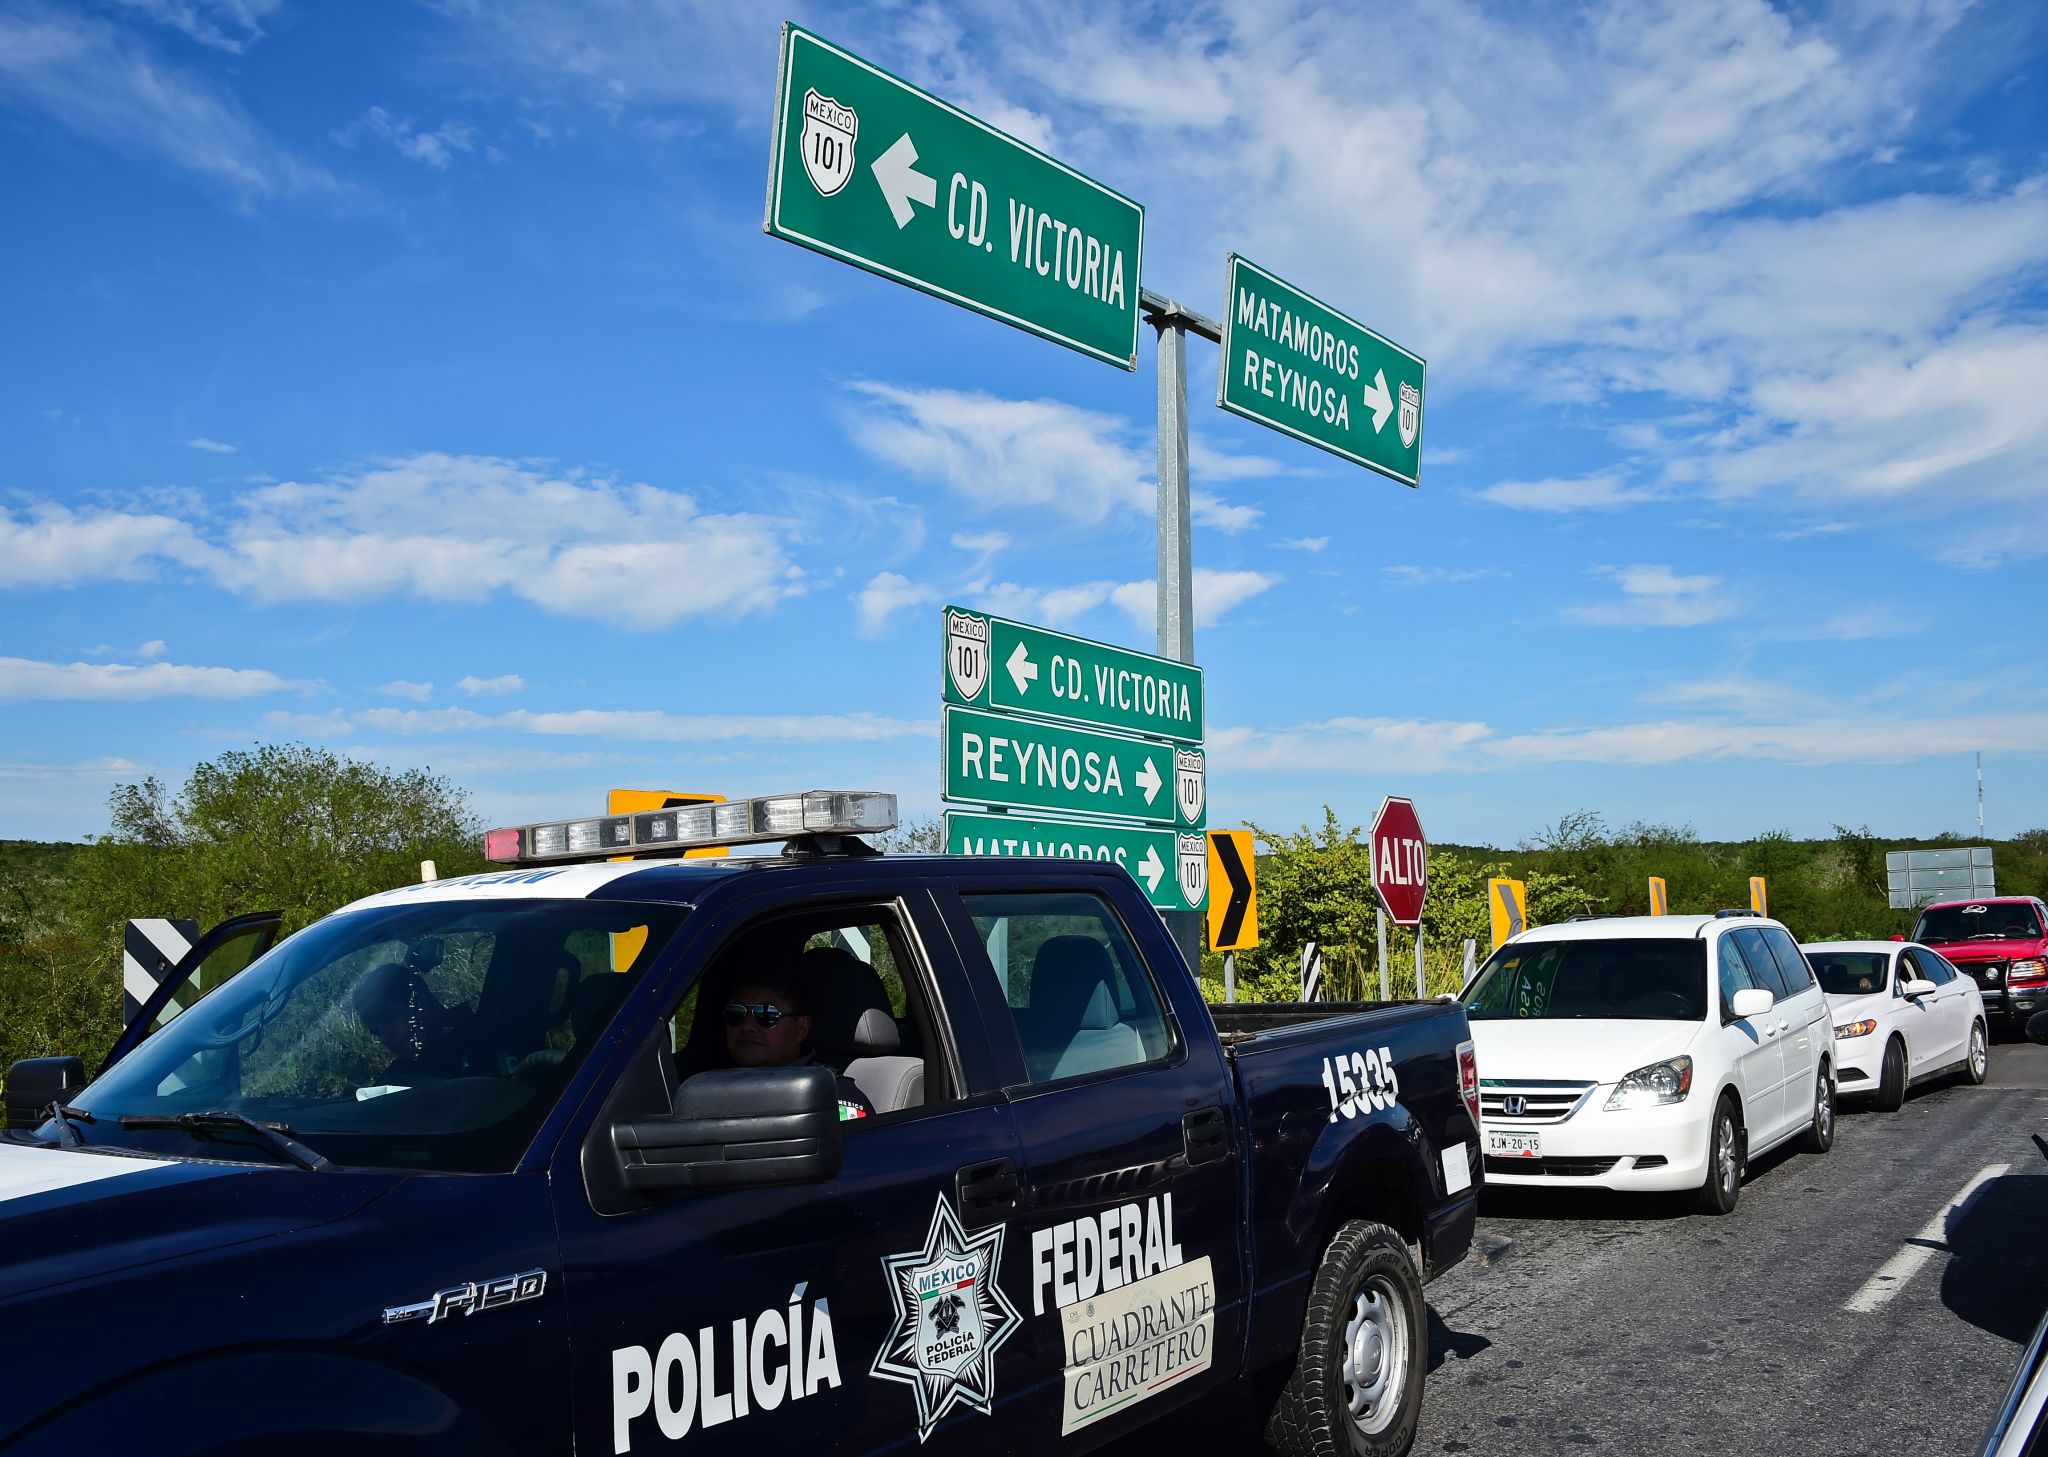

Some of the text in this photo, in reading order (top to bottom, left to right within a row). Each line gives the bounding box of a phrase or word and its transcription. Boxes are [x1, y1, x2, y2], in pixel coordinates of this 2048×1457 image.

[810, 99, 852, 129] MEXICO
[815, 132, 843, 174] 101
[948, 172, 1125, 311] CD. VICTORIA
[1238, 286, 1359, 380] MATAMOROS
[1243, 349, 1350, 431] REYNOSA
[1402, 407, 1414, 433] 101
[952, 619, 984, 638] MEXICO
[958, 645, 978, 680] 101
[1050, 654, 1192, 723] CD. VICTORIA
[962, 732, 1124, 797] REYNOSA
[1178, 758, 1201, 770] MEXICO
[1183, 778, 1199, 806] 101
[1181, 841, 1204, 850] MEXICO
[1380, 836, 1425, 887] ALTO
[1185, 861, 1201, 889] 101
[1322, 1046, 1399, 1124] 15335
[919, 1261, 976, 1292] MÉXICO
[612, 1192, 1183, 1455] POLICÍA FEDERAL
[1072, 1281, 1211, 1368] CUADRANTE
[926, 1331, 975, 1356] POLICÍA
[927, 1341, 977, 1367] FEDERAL
[1073, 1323, 1207, 1411] CARRETERO
